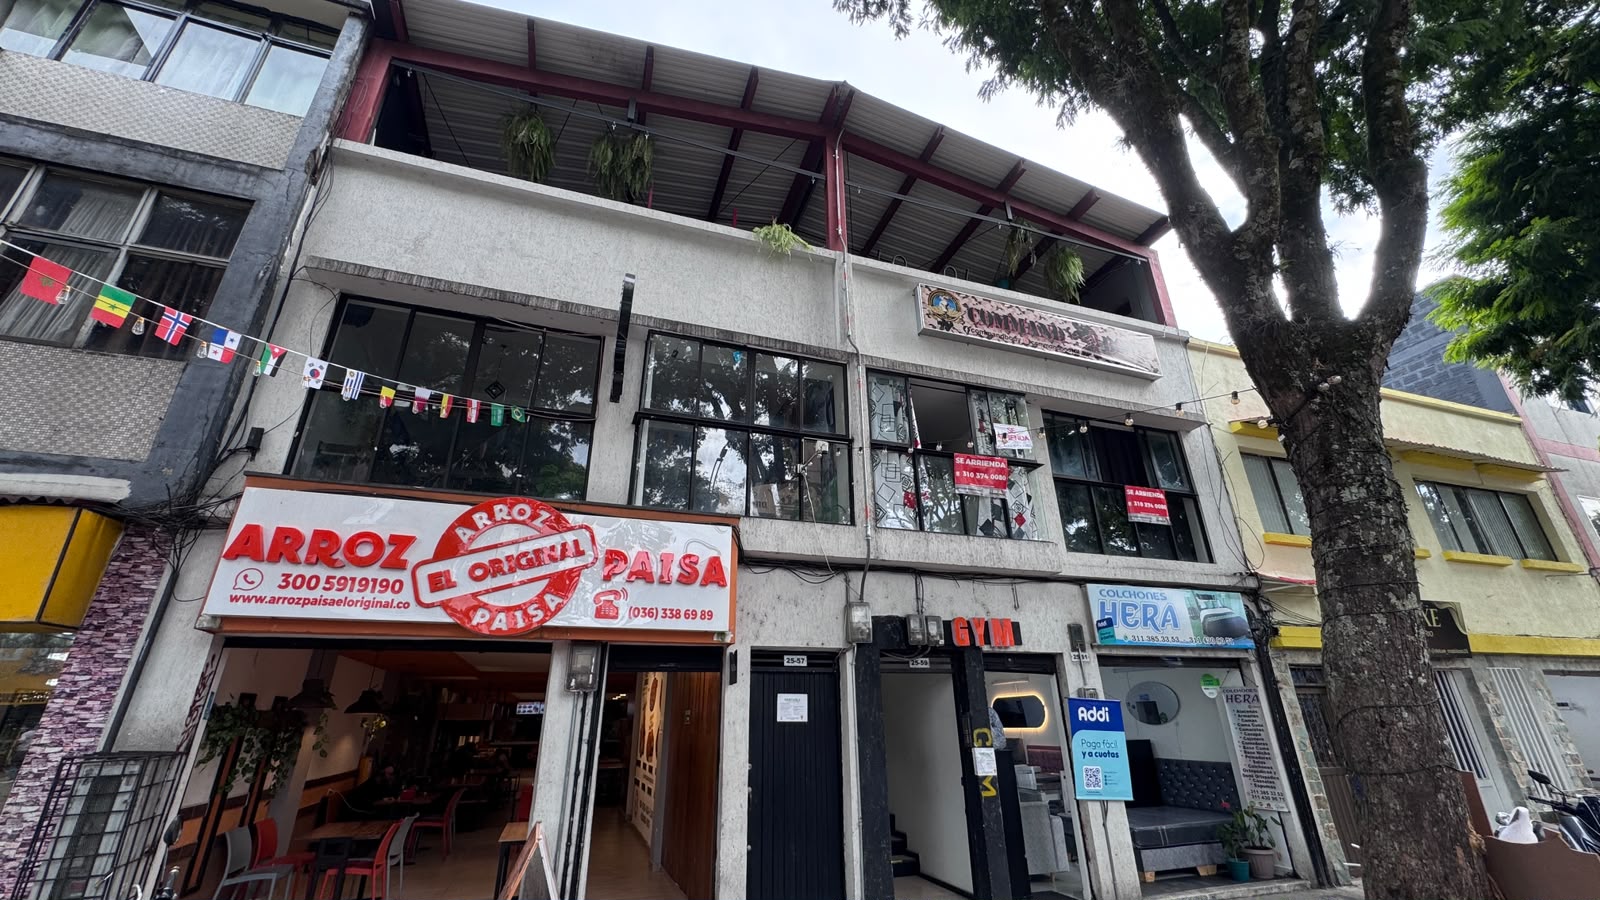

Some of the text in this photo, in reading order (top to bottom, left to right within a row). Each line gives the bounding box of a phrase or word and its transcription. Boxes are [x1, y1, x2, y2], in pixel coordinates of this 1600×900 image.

[966, 459, 1006, 468] ARRIENDA
[1135, 490, 1165, 499] ARRIENDA
[454, 503, 551, 544] ARROZ
[222, 523, 417, 570] ARROZ
[427, 539, 586, 593] EL ORIGINAL
[602, 548, 727, 587] PAISA
[277, 573, 404, 594] 300 5919190
[229, 593, 411, 610] www.arrozpaisaeloriginal.co
[1099, 589, 1167, 601] COLCHONES
[471, 593, 565, 631] PAISA
[628, 606, 713, 621] (036) 338 69 89
[1100, 601, 1180, 633] HERA
[1421, 608, 1441, 628] XE
[951, 616, 1015, 648] GYM
[1226, 694, 1259, 704] HERA
[1078, 706, 1110, 722] Addi
[1081, 739, 1118, 750] Paga fácil
[1081, 751, 1087, 759] y
[1094, 750, 1120, 759] cuotas
